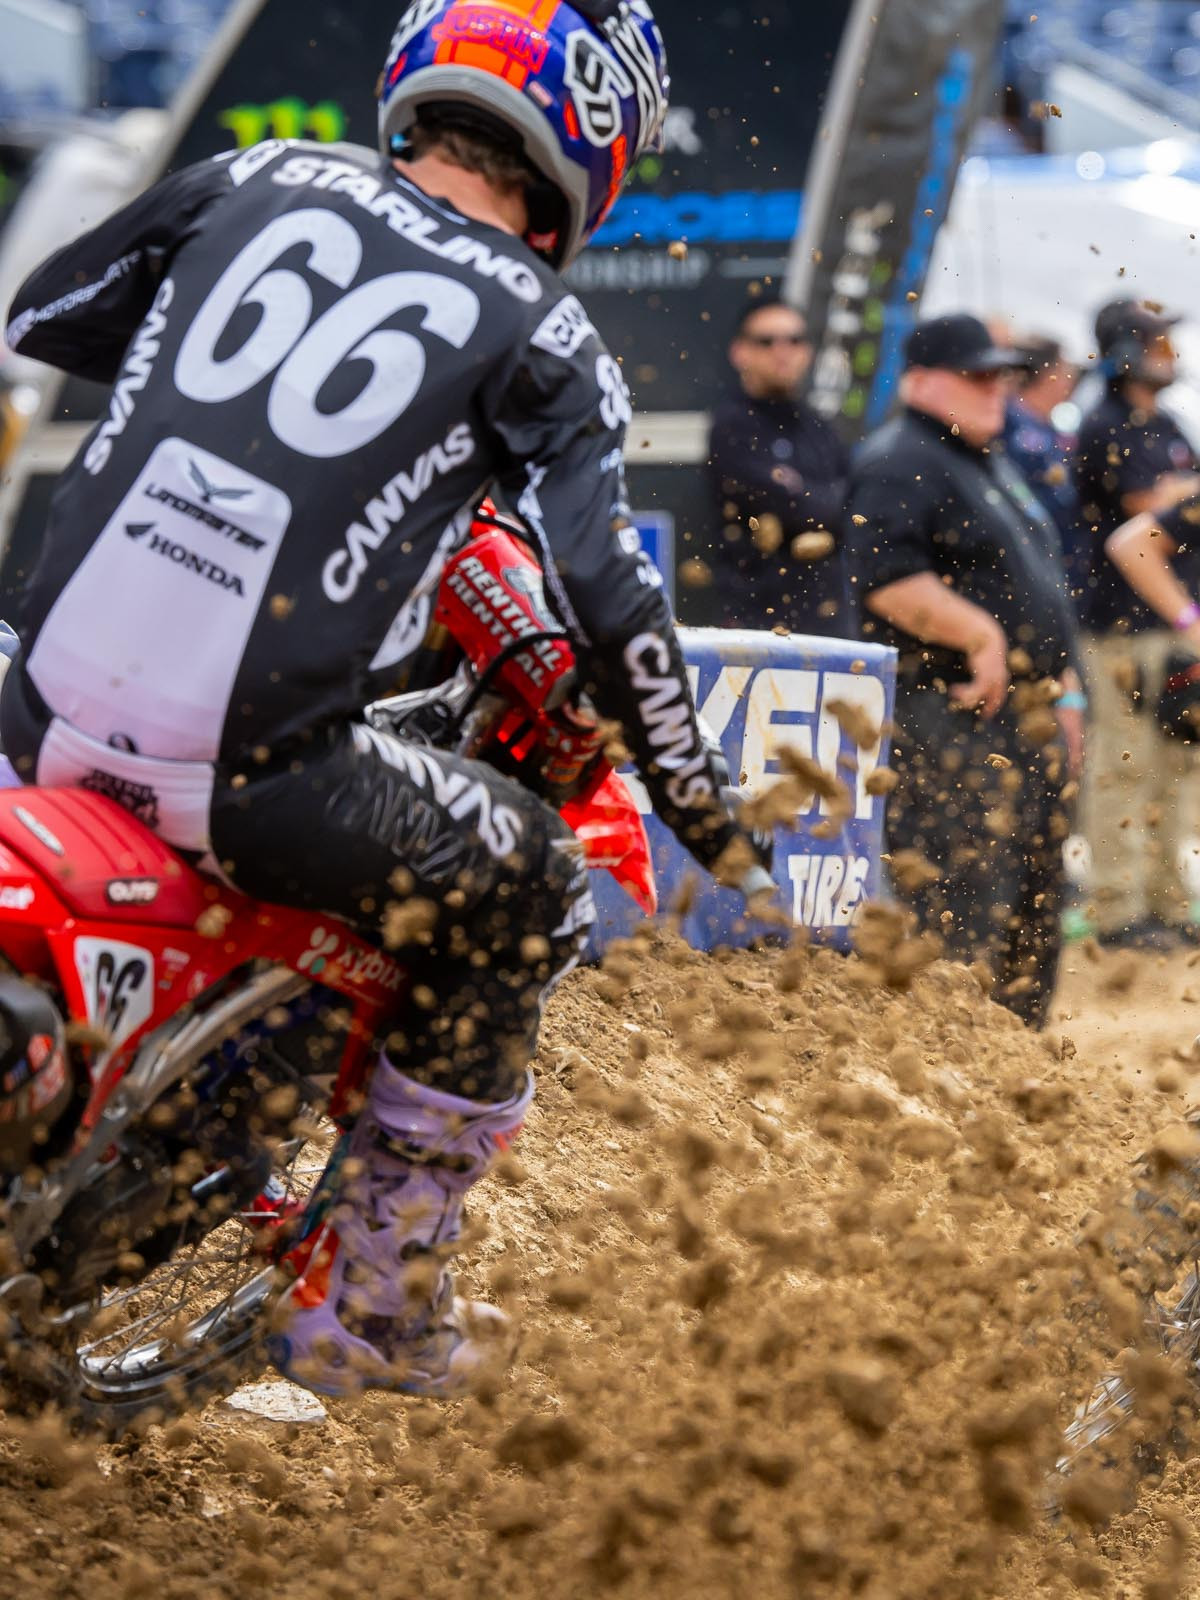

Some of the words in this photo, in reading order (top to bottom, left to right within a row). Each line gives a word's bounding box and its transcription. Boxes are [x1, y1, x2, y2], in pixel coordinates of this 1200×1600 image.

[272, 153, 542, 303] STARLING
[82, 278, 175, 476] CANVAS
[173, 207, 481, 458] 66
[149, 533, 245, 597] HONDA
[321, 422, 476, 603] CANVAS
[456, 554, 563, 672] RENTHAL
[623, 632, 714, 810] CANVAS
